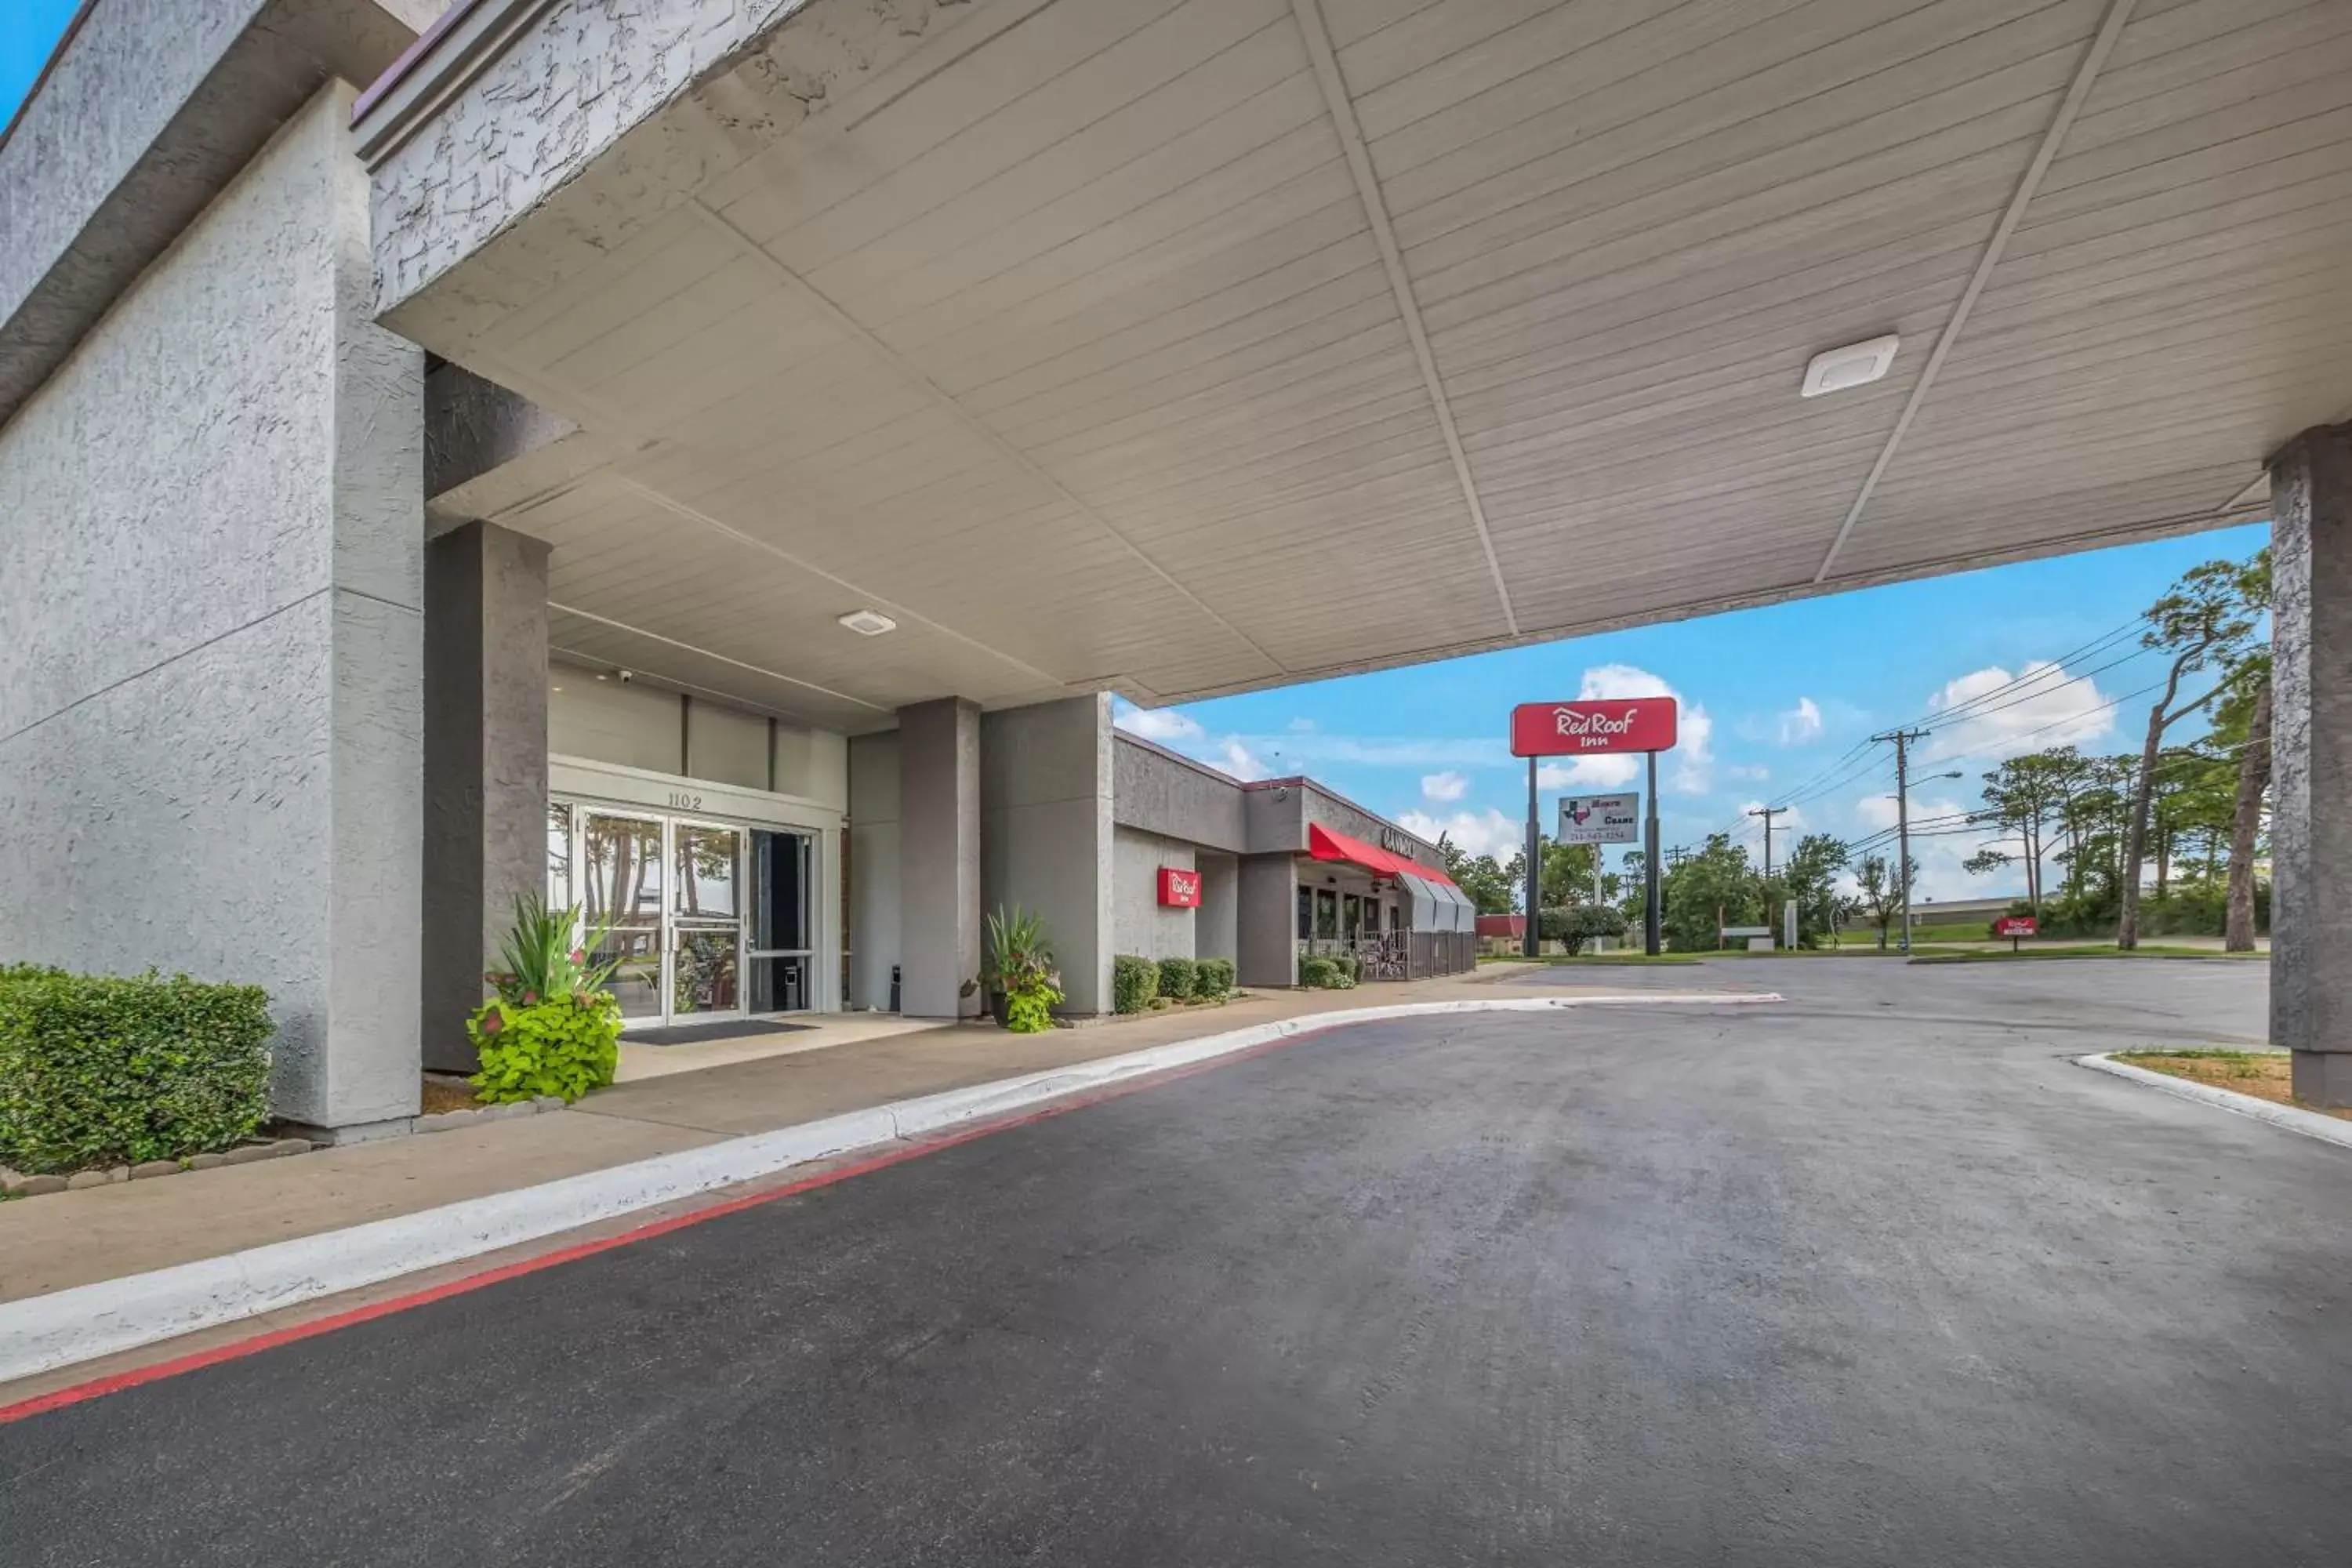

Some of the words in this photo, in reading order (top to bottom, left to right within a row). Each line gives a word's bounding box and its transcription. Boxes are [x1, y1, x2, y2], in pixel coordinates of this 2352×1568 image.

[1556, 713, 1590, 735] Red
[1592, 708, 1638, 735] Roof
[668, 792, 702, 810] 1102
